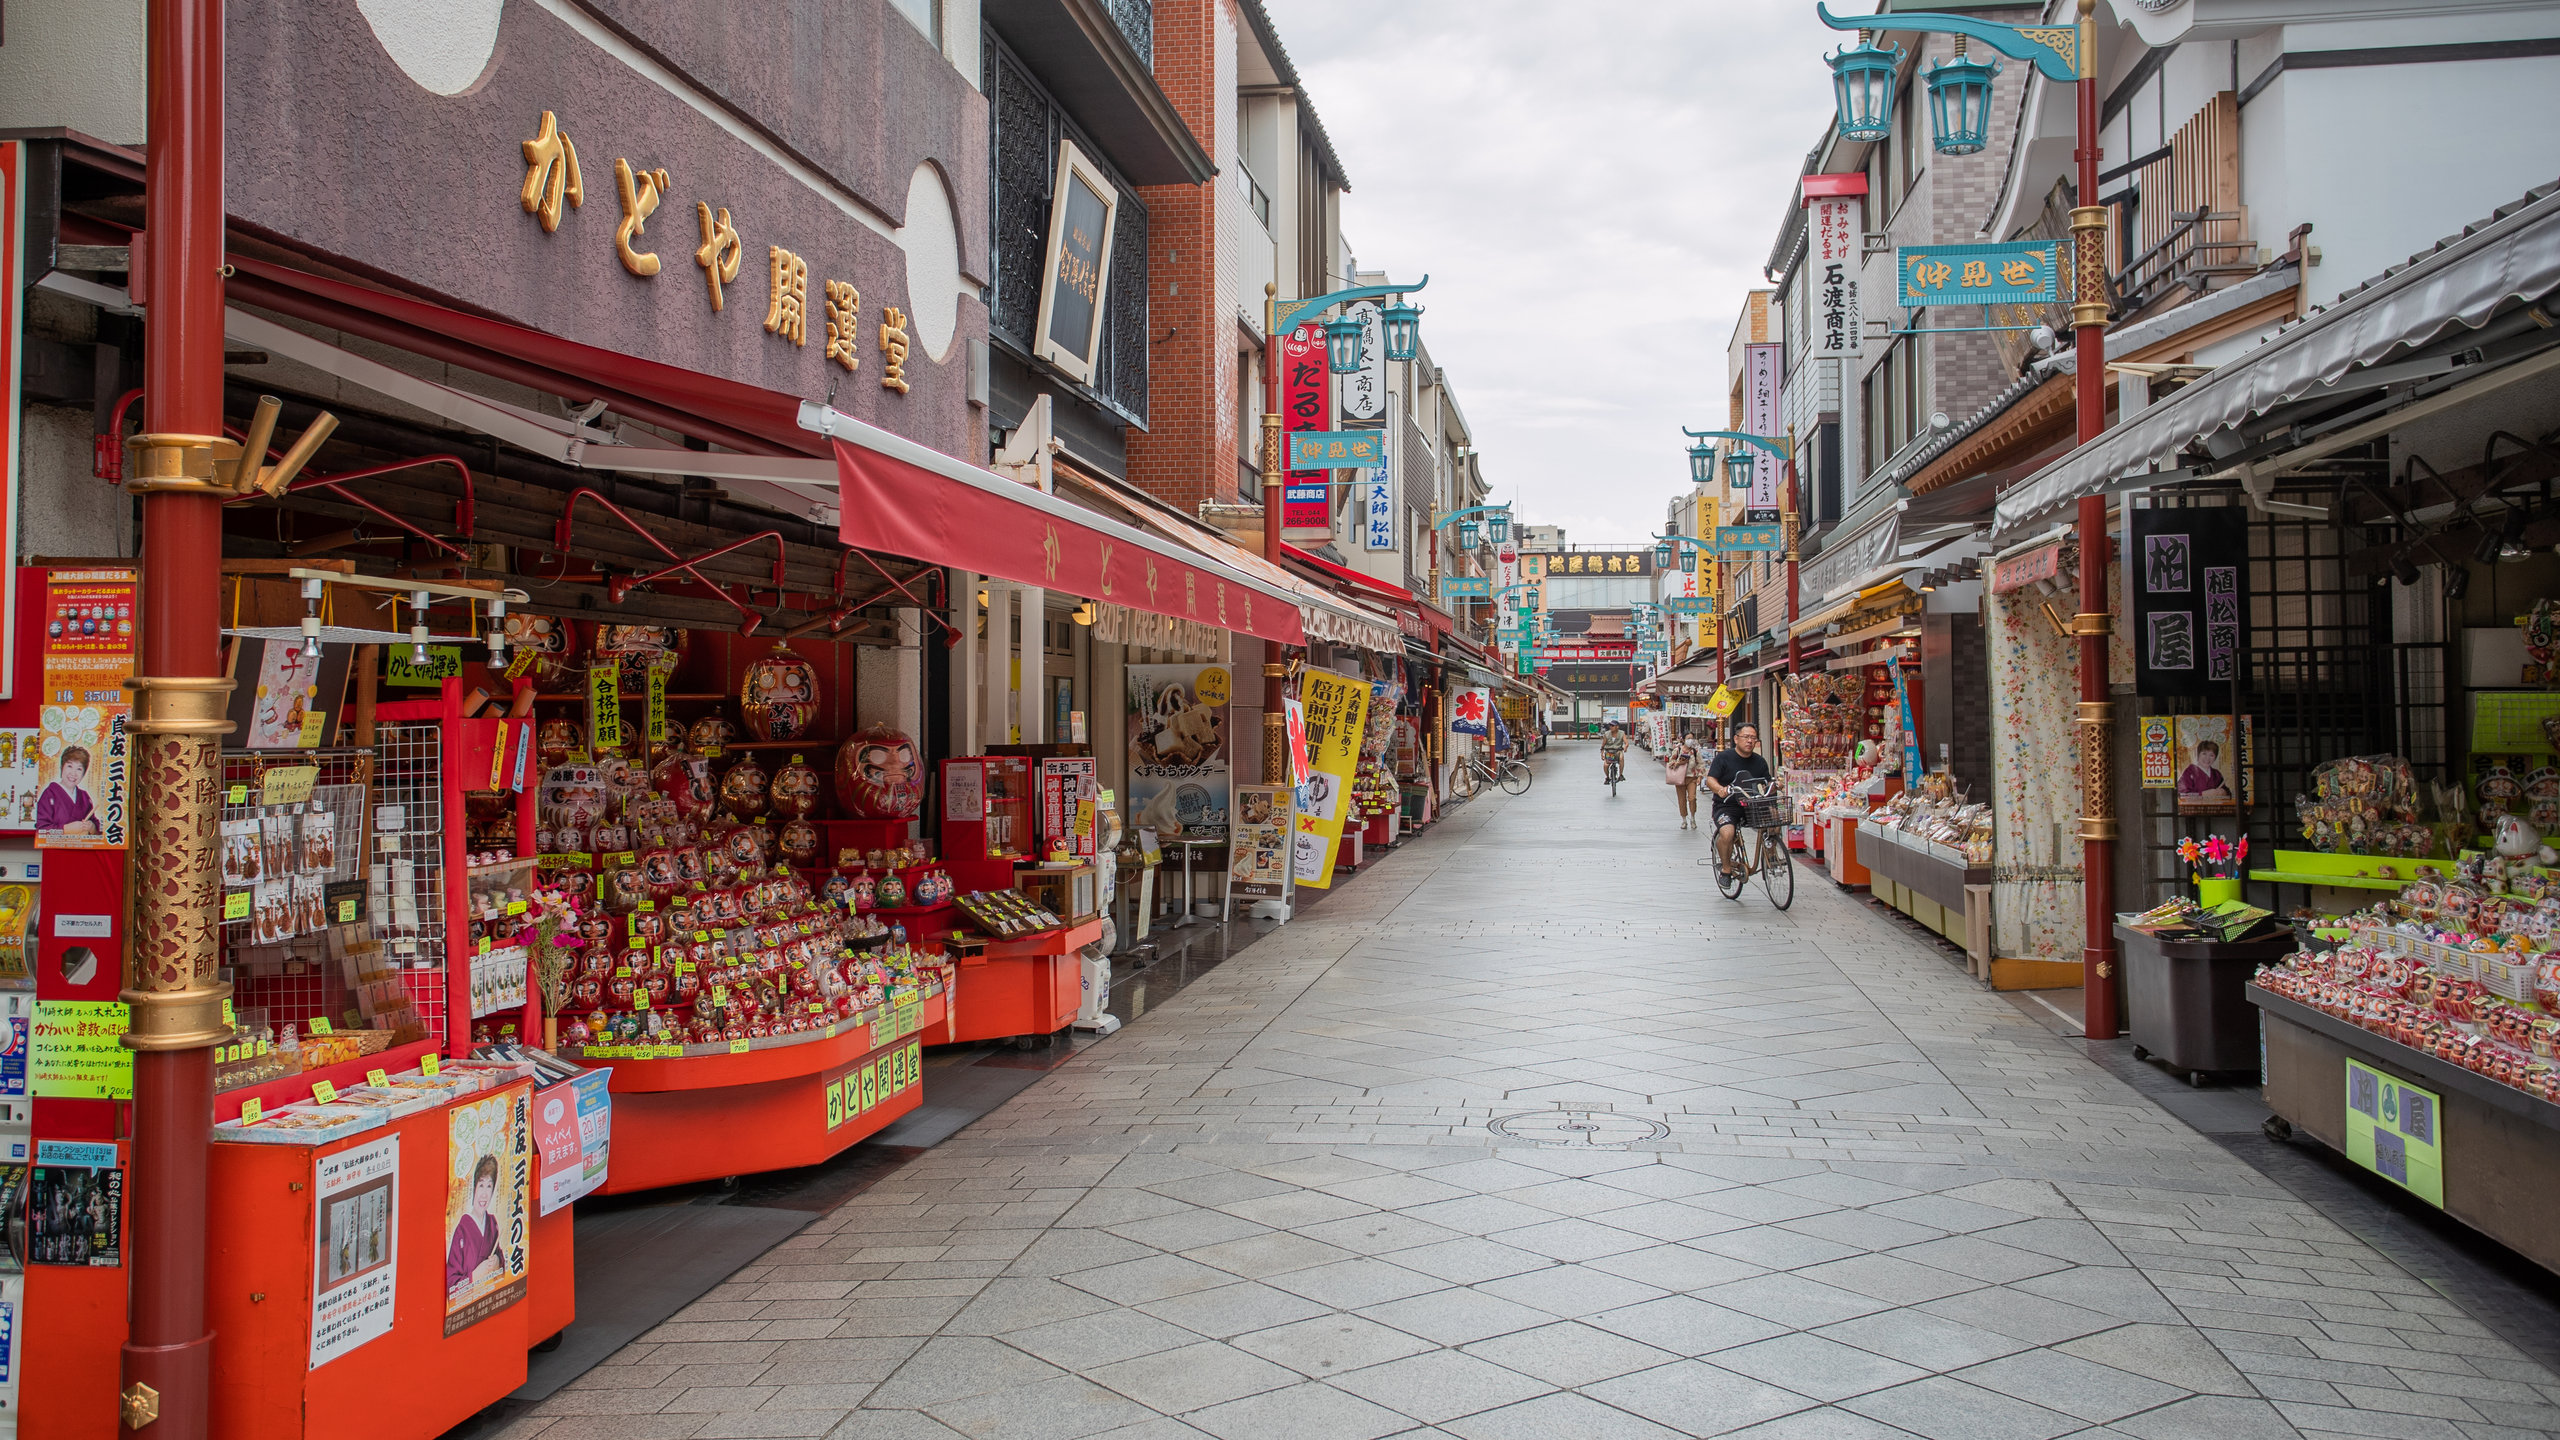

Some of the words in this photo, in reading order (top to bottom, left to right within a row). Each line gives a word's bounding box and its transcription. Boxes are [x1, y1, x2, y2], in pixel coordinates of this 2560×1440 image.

[1820, 203, 1833, 260] 開運だるま
[1837, 203, 1850, 259] おみやげ
[520, 110, 910, 393] かどや開運堂
[1916, 260, 2036, 290] 仲見世
[1823, 263, 1846, 351] 石渡商店
[1302, 441, 1372, 459] 仲見世
[1287, 489, 1325, 499] 武藤商店
[1285, 517, 1326, 525] 266-9008
[1723, 534, 1771, 544] 仲見世
[1043, 522, 1253, 631] かどや開運堂
[1448, 582, 1484, 591] 仲見世
[2148, 536, 2192, 668] 柏屋
[1098, 601, 1130, 644] SOFT
[2207, 568, 2238, 680] 植松商店
[281, 647, 304, 683] 子
[592, 669, 613, 678] 必勝
[84, 690, 121, 702] 350円
[595, 679, 618, 742] 合格祈願
[650, 677, 663, 737] 合格祈願
[1327, 684, 1347, 737] オリジナル
[768, 703, 794, 741] 必勝
[1340, 687, 1363, 757] 久寿餅にあう
[1047, 762, 1092, 774] 令和二年
[1134, 764, 1226, 778] くずもちサンデー
[2145, 766, 2170, 777] 110番
[2146, 754, 2170, 765] こども
[1179, 792, 1199, 802] MILK
[1063, 777, 1077, 854] 神宮館高島暦
[192, 742, 219, 981] 厄除け弘法大師
[38, 1006, 74, 1017] 川崎大師
[35, 1021, 75, 1037] かわいい
[829, 1047, 919, 1121] かどや開運堂
[545, 1125, 572, 1146] ペイペイ
[548, 1140, 578, 1165] 使えます。
